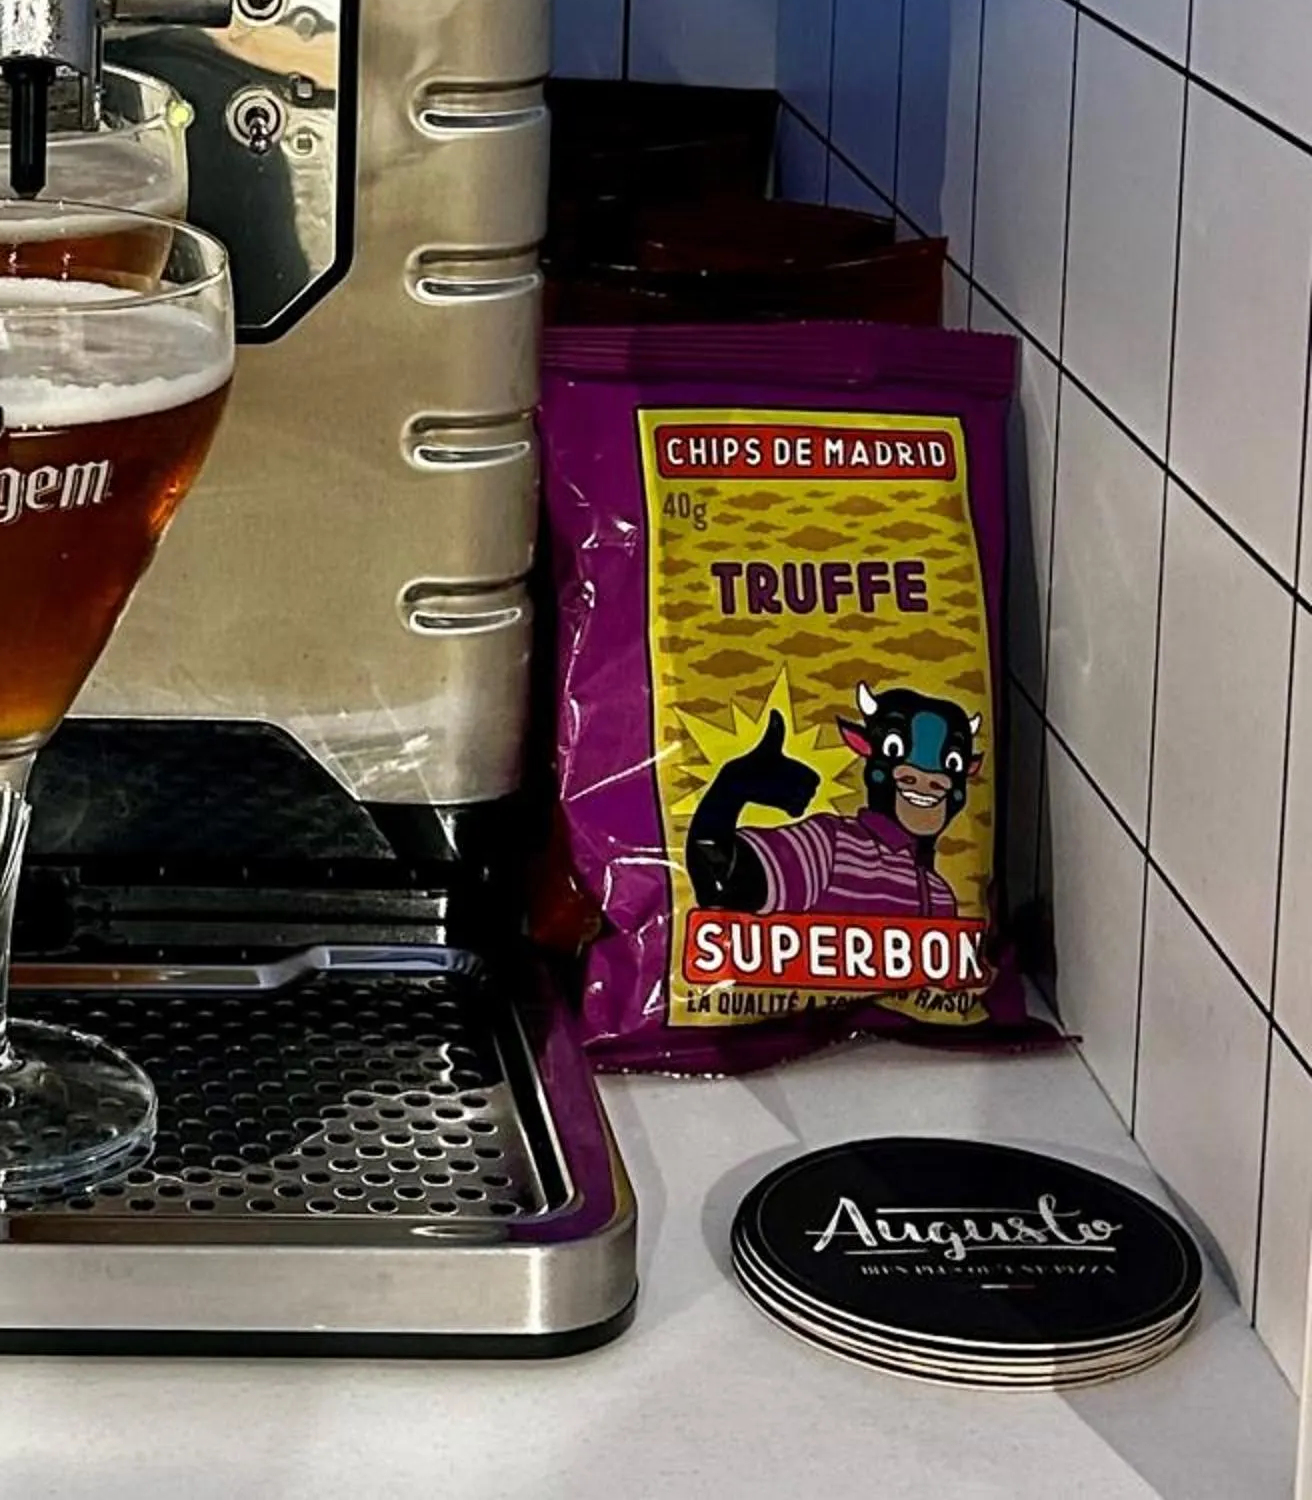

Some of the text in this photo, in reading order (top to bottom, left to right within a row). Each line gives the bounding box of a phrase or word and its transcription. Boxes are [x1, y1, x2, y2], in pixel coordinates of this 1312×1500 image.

[666, 437, 947, 468] CHIPS DE MADRID
[662, 492, 708, 531] 40g
[710, 561, 929, 615] TRUFFE
[694, 922, 984, 980] SUPERBON
[687, 989, 711, 1012] LA
[718, 988, 800, 1016] QUALITÉ
[804, 1192, 1124, 1261] Augusto
